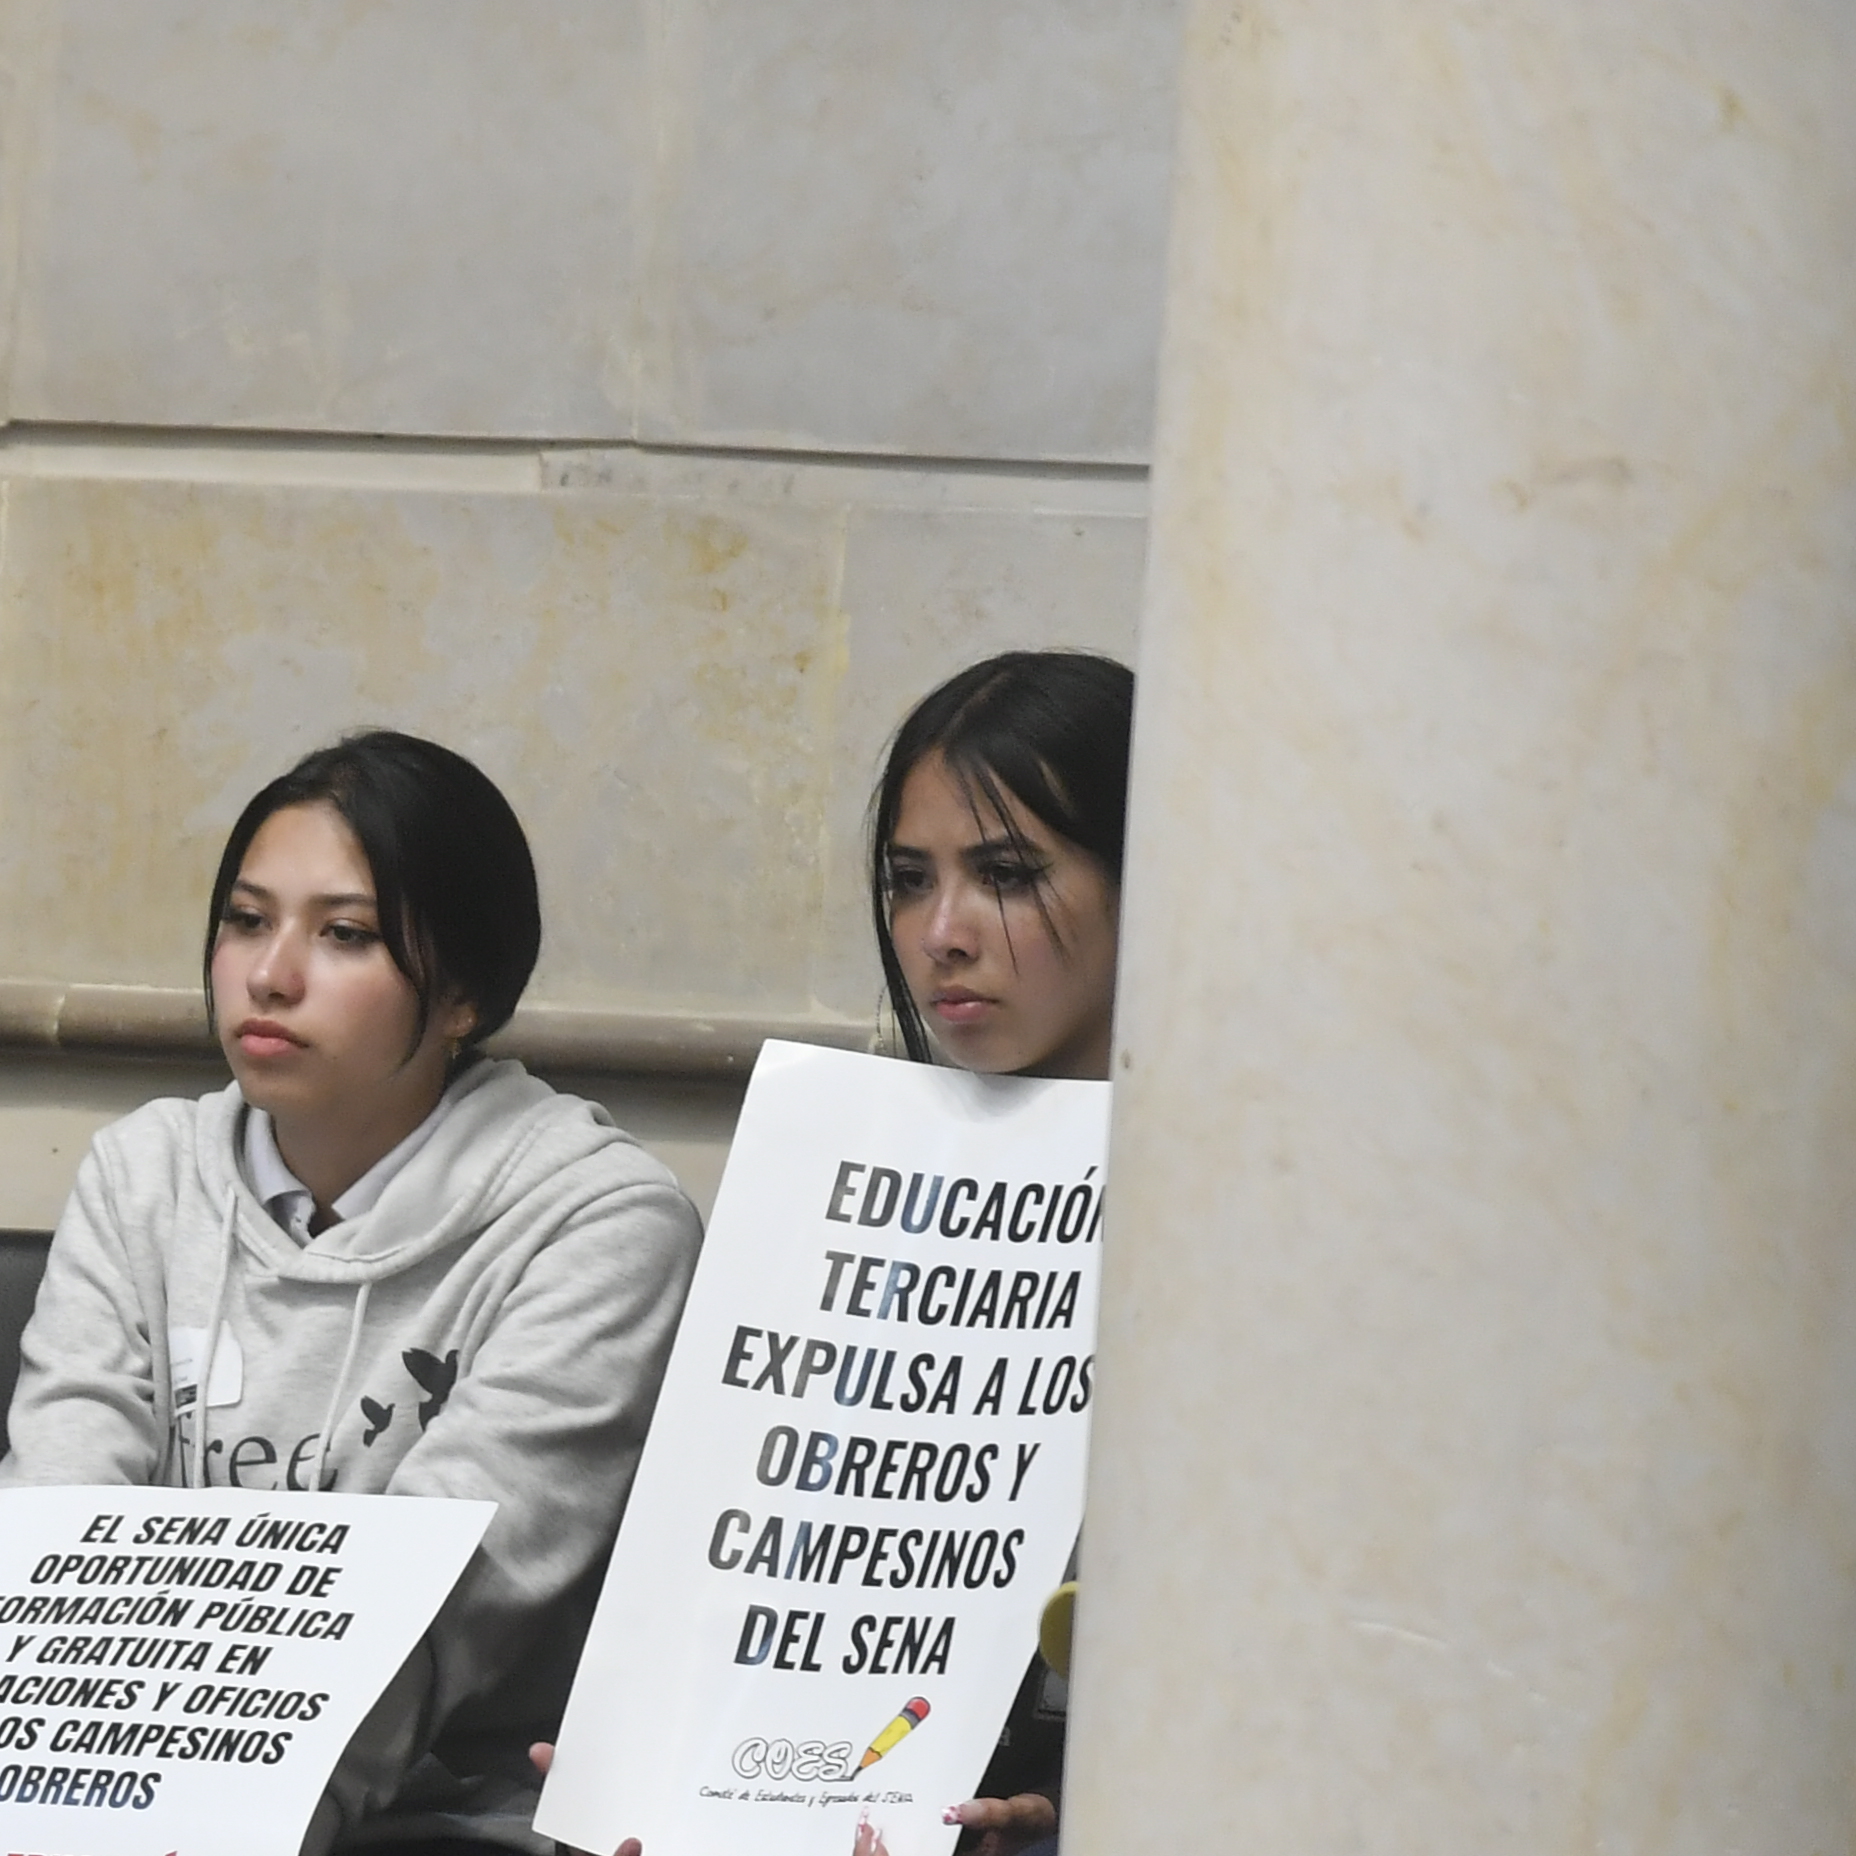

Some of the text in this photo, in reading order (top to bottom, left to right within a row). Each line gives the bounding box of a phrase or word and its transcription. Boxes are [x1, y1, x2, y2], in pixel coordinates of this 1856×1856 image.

[820, 1251, 1081, 1329] TERCIARIA
[722, 1326, 1095, 1415] EXPULSA A LOS
[757, 1426, 1040, 1502] OBREROS Y
[81, 1513, 349, 1554] EL SENA ÚNICA
[709, 1509, 1024, 1589] CAMPESINOS
[30, 1555, 342, 1597] OPORTUNIDAD DE
[194, 1597, 354, 1640] PÚBLICA
[734, 1605, 955, 1674] DEL SENA
[5, 1636, 272, 1675] Y GRATUITA EN
[153, 1682, 181, 1711] Y
[183, 1685, 329, 1721] OFICIOS
[50, 1720, 292, 1764] CAMPESINOS
[732, 1737, 853, 1782] COES
